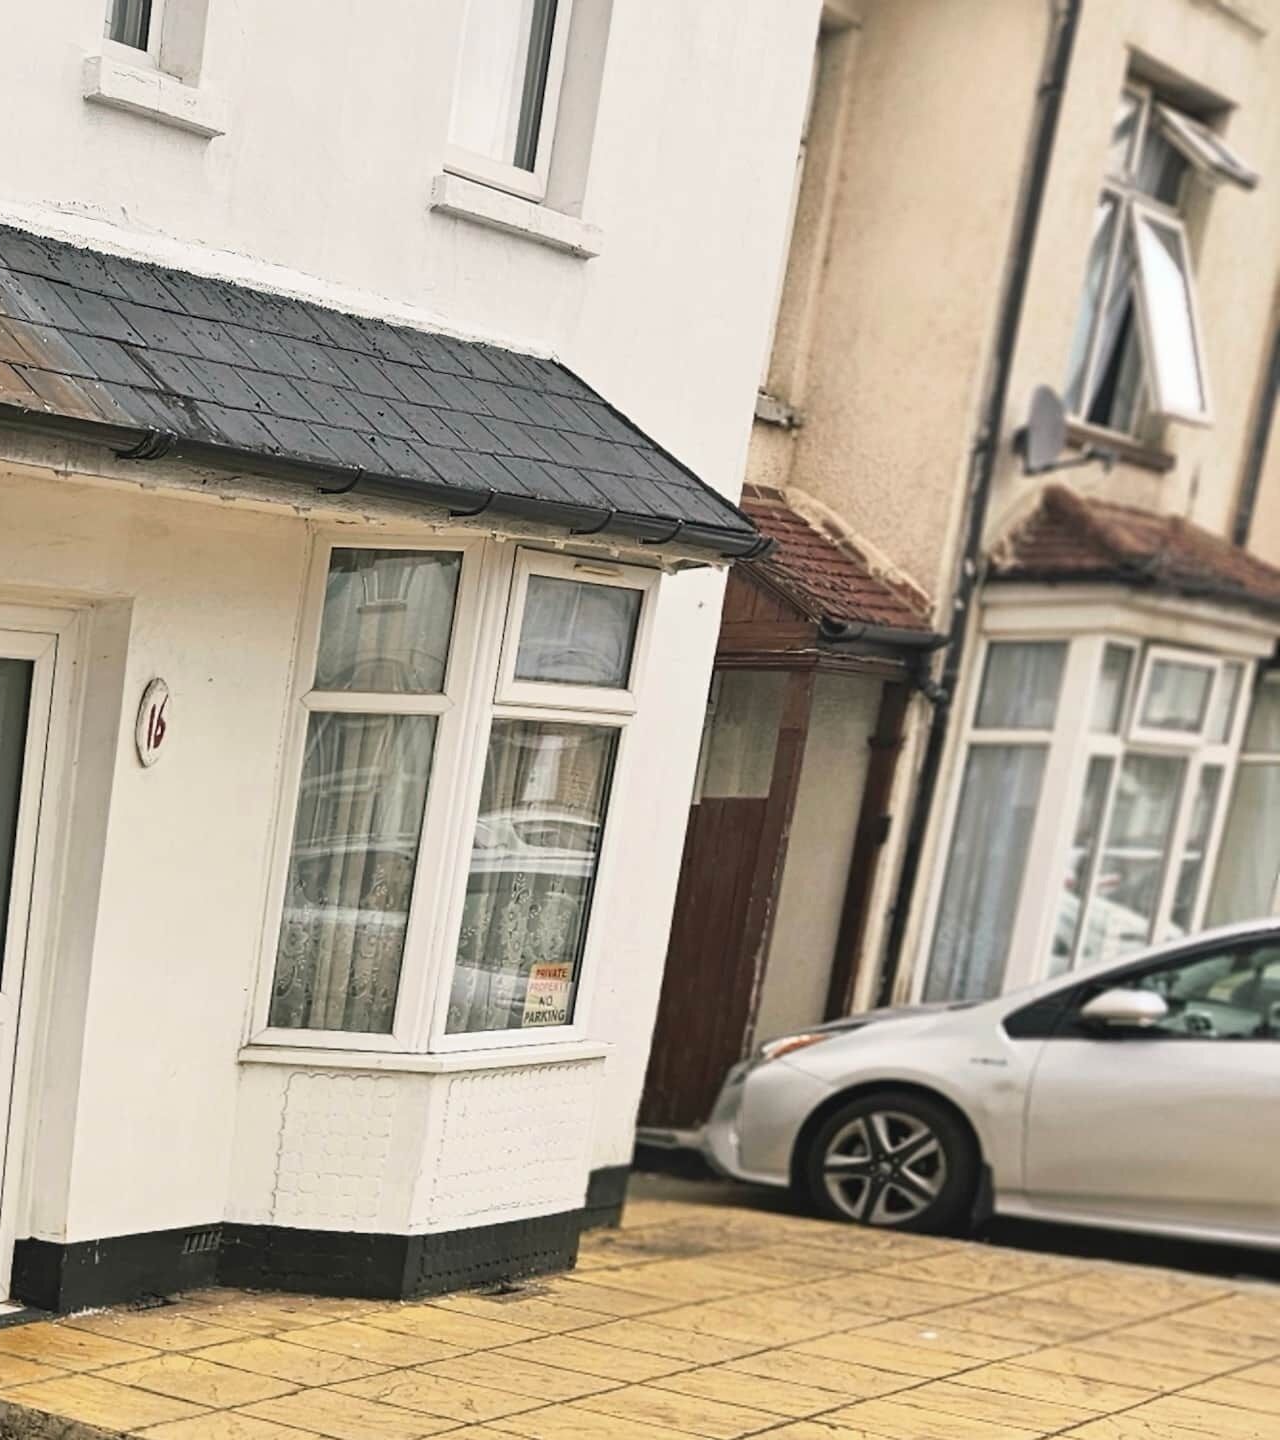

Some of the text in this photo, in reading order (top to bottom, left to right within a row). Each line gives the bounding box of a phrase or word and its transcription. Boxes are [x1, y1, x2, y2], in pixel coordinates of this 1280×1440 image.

[147, 694, 169, 752] 16
[536, 968, 569, 979] PRIVATE
[524, 1009, 566, 1025] PARKING
